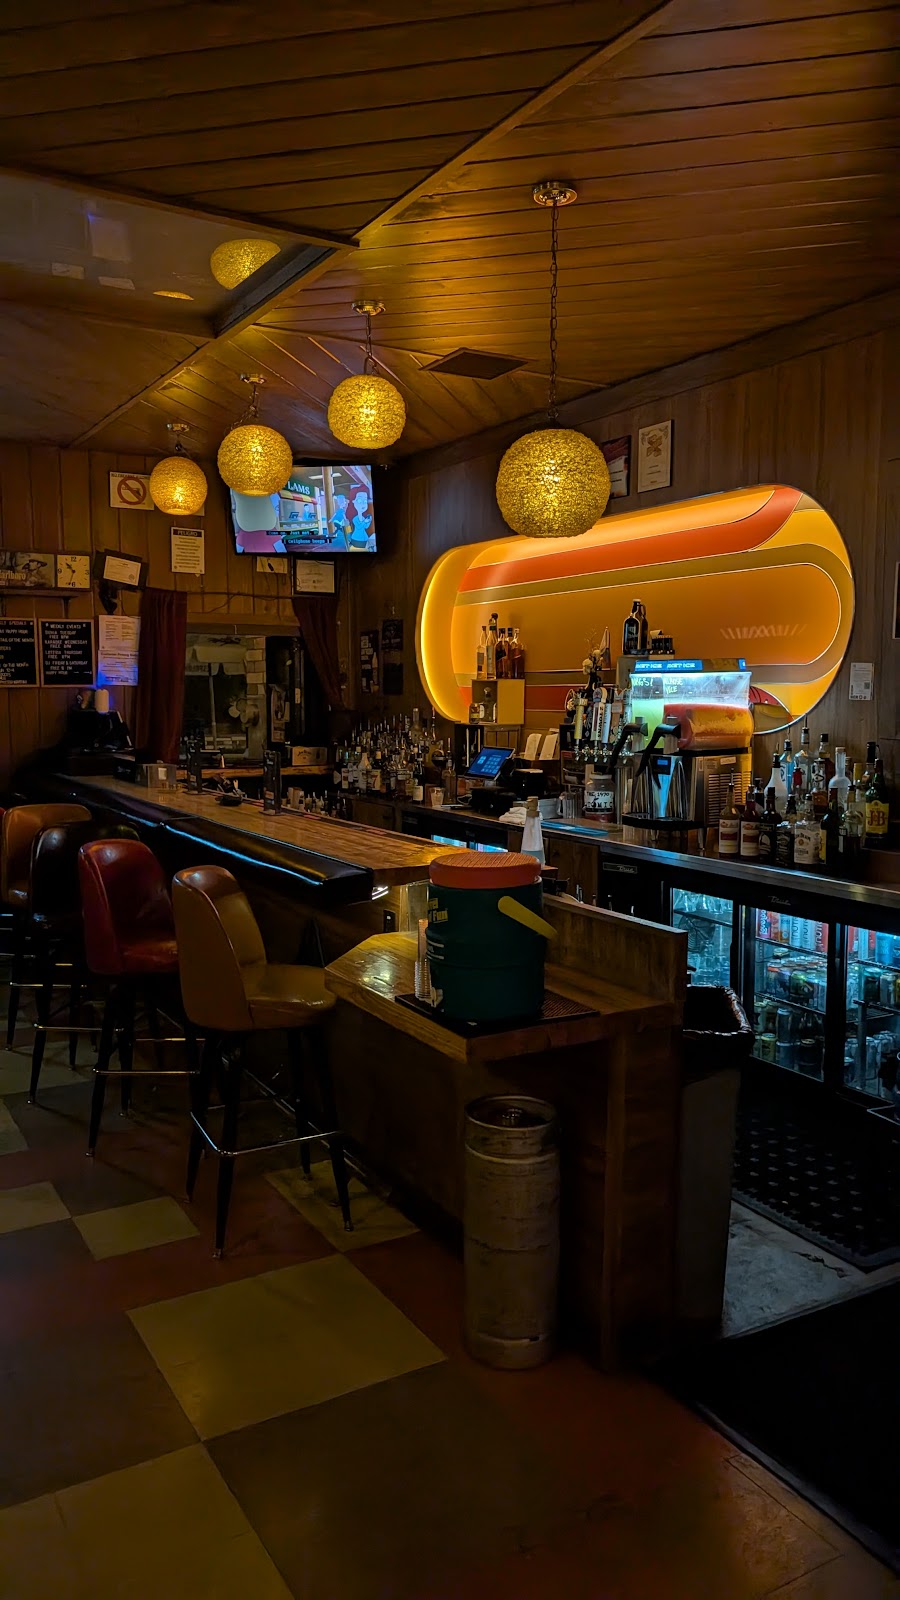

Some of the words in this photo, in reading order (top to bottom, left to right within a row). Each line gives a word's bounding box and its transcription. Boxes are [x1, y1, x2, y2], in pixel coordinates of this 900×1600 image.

[285, 481, 310, 495] LAMS
[0, 570, 26, 580] arlboro
[617, 865, 635, 873] True
[768, 896, 792, 906] True
[433, 909, 448, 922] Fun
